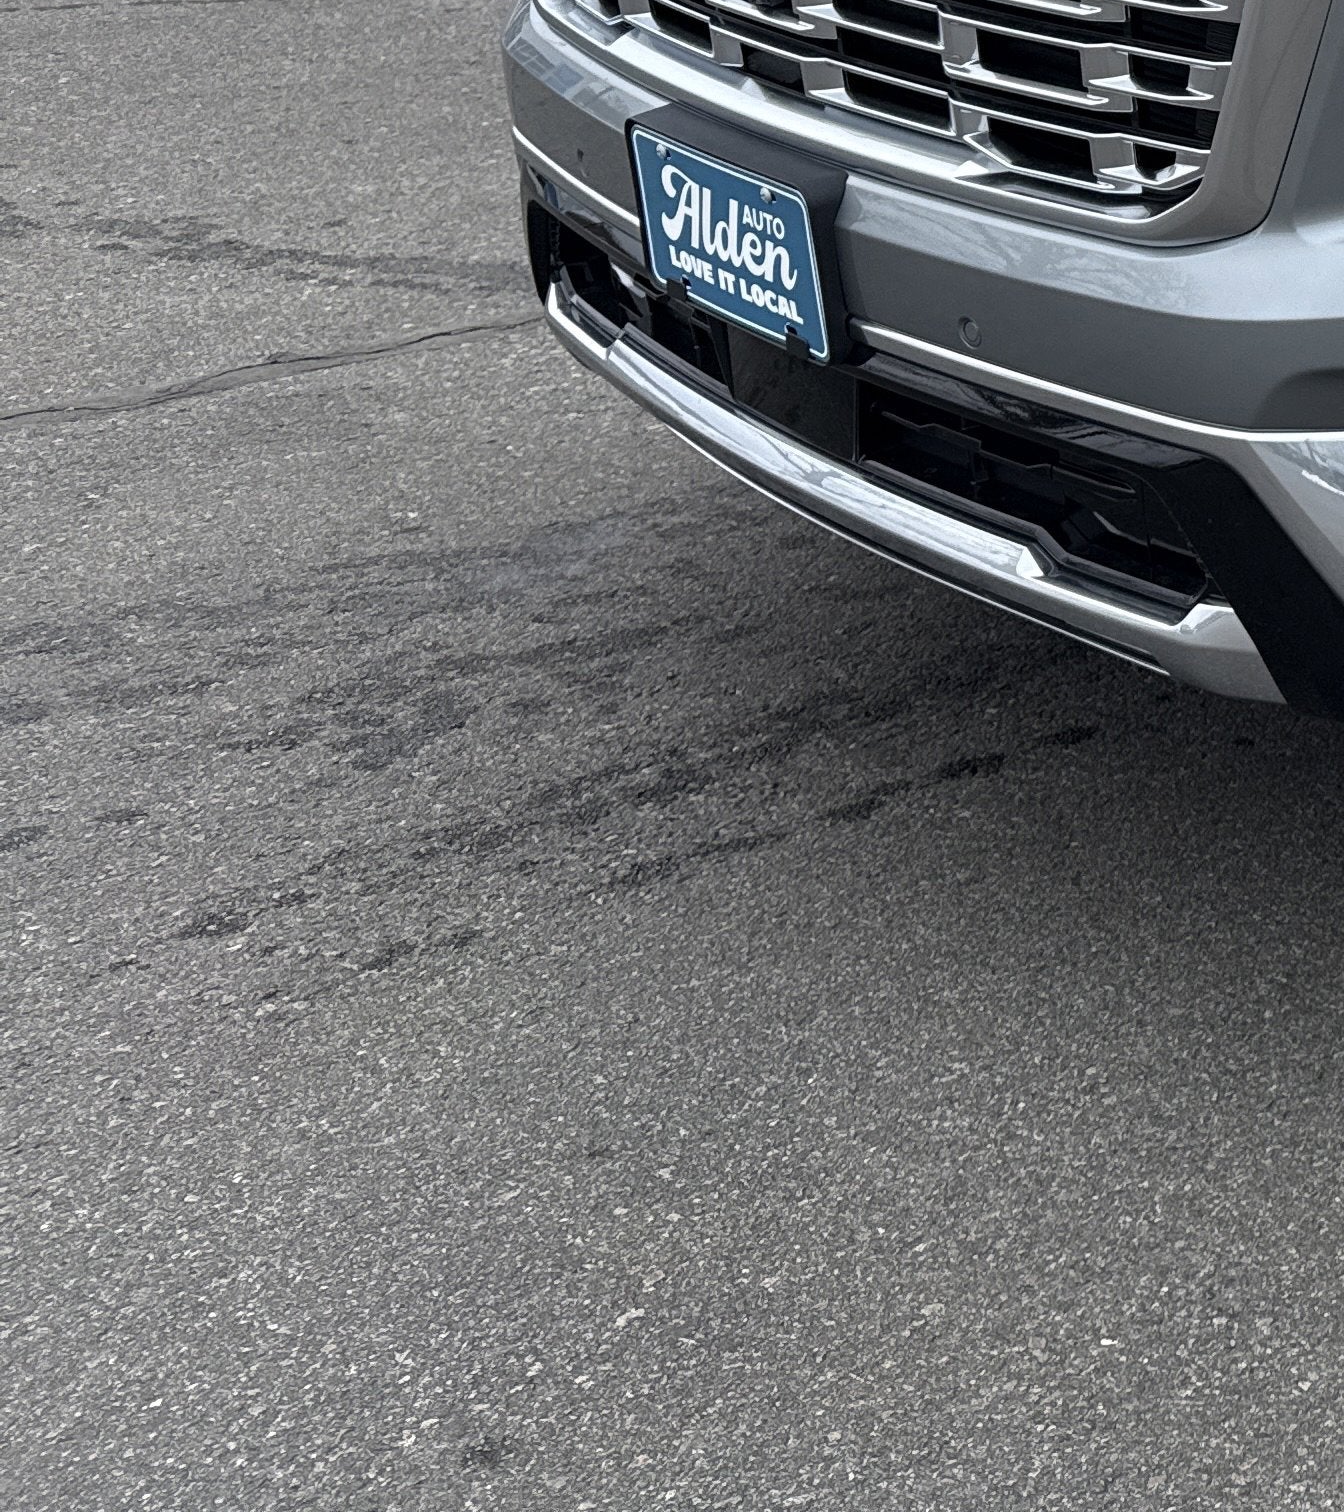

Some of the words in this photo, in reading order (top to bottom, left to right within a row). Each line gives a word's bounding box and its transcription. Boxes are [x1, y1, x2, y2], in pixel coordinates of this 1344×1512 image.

[661, 164, 798, 290] Alden
[743, 204, 785, 240] AUTO
[669, 244, 715, 285] LOVE
[717, 267, 736, 294] IT
[739, 278, 804, 325] LOCAL
